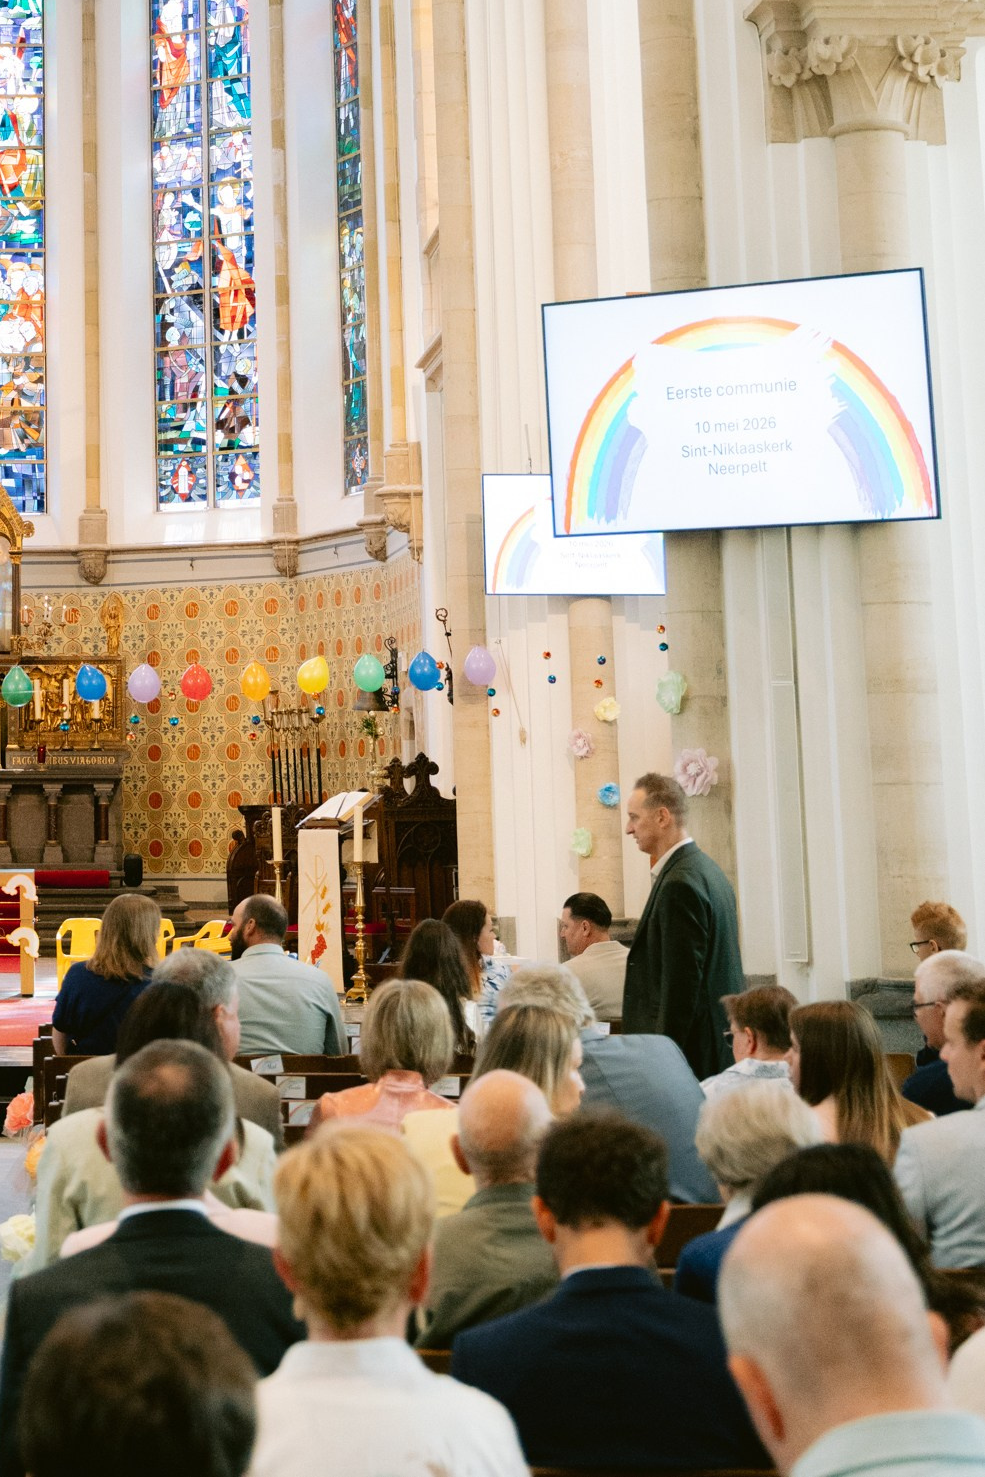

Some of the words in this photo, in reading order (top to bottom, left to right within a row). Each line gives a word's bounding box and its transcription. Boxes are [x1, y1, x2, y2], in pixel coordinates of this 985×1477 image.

[666, 385, 712, 401] Eerste
[716, 377, 797, 397] communie
[695, 420, 710, 434] 10
[714, 418, 738, 433] mei
[743, 416, 777, 431] 2026
[681, 438, 793, 459] Sint-Niklaaskerk
[708, 459, 767, 476] Neerpelt
